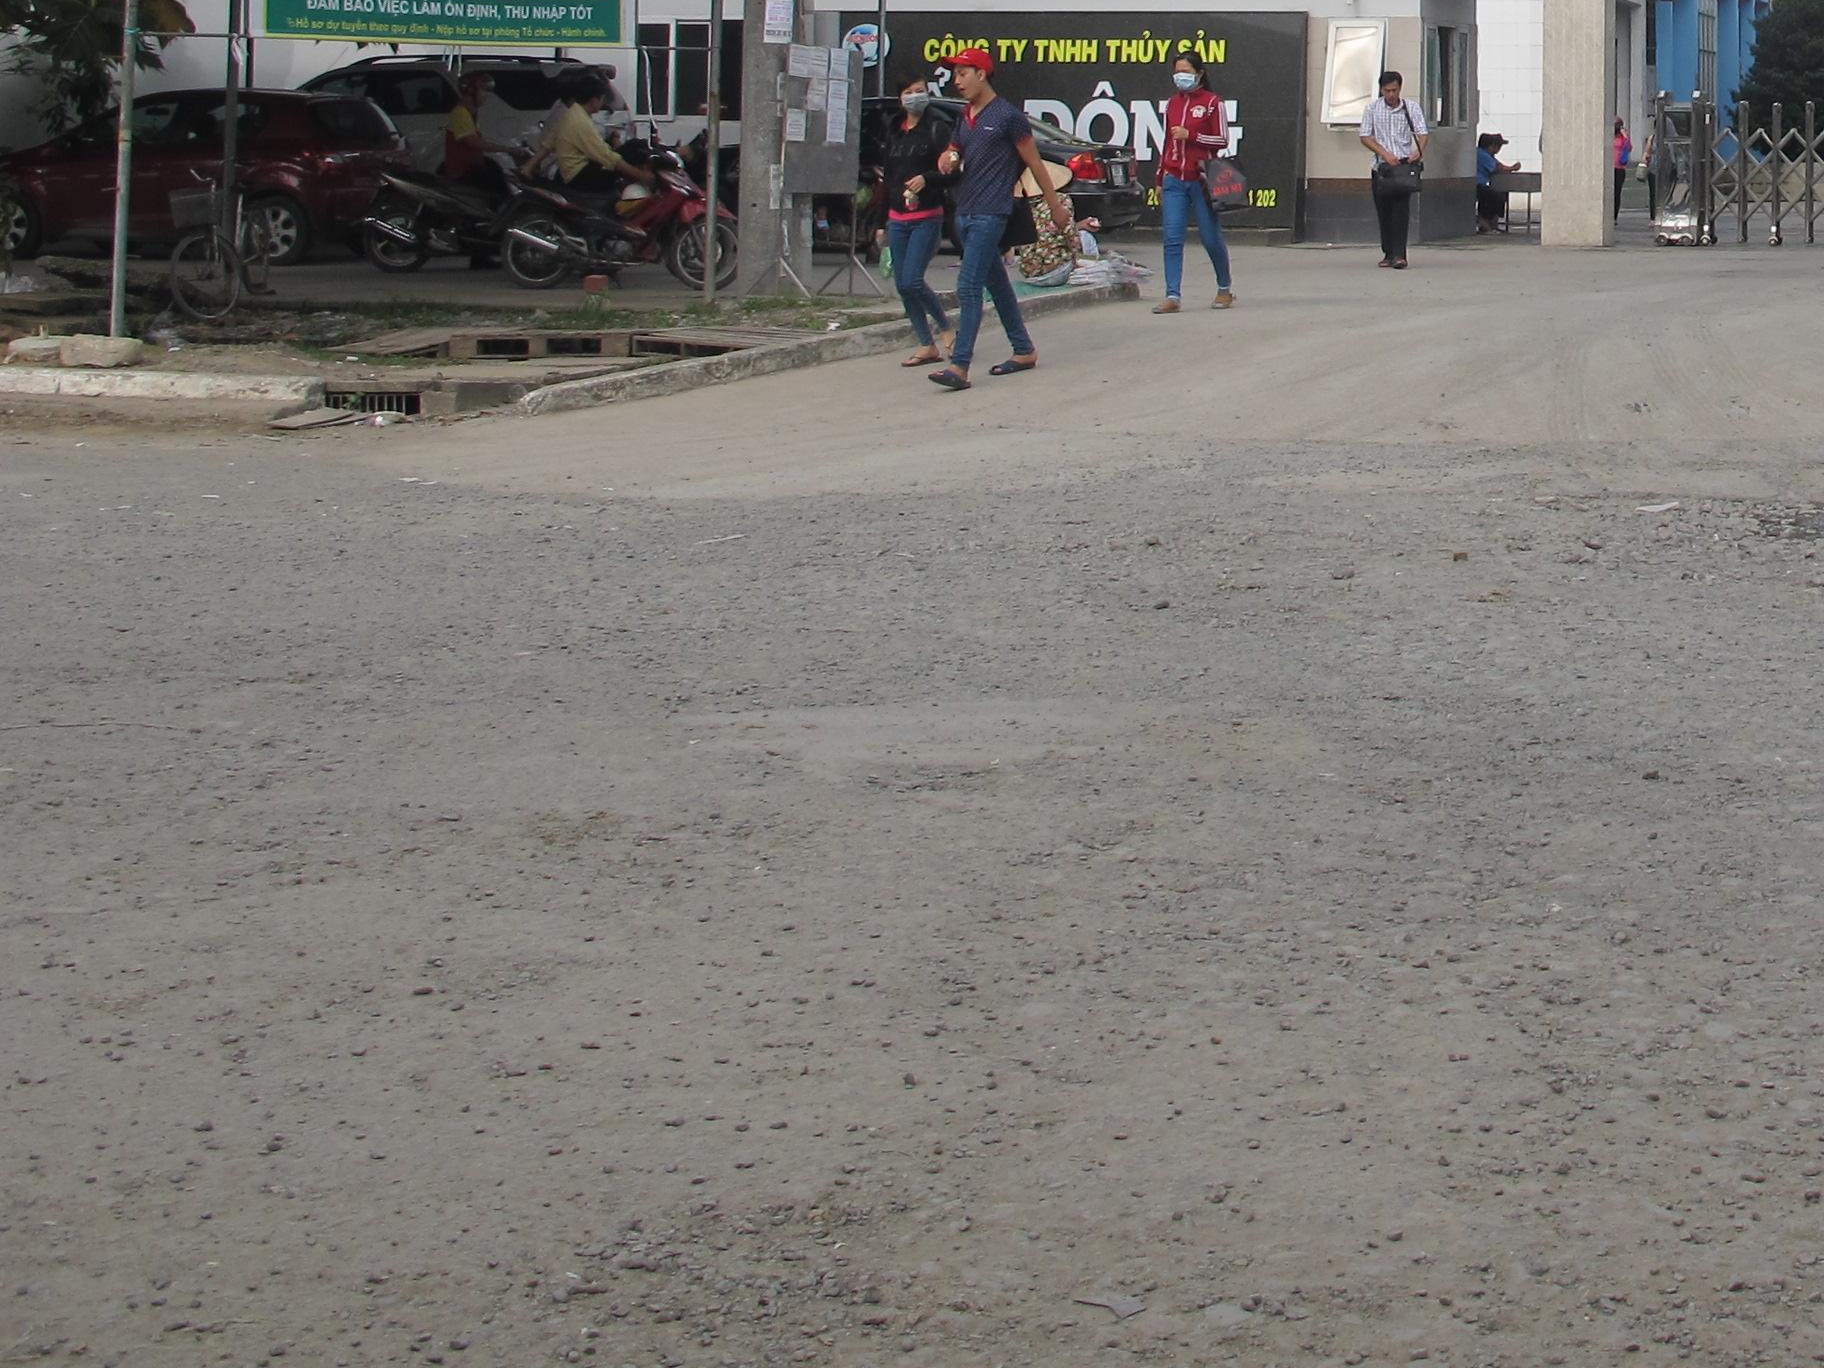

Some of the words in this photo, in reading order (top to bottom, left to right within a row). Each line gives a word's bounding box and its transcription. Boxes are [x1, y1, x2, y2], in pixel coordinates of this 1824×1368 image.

[504, 5, 530, 19] THU
[532, 5, 567, 23] NHẬP
[996, 38, 1028, 63] TY
[1033, 38, 1099, 63] TNHH
[1105, 30, 1171, 63] THỦY
[1256, 188, 1277, 208] 202
